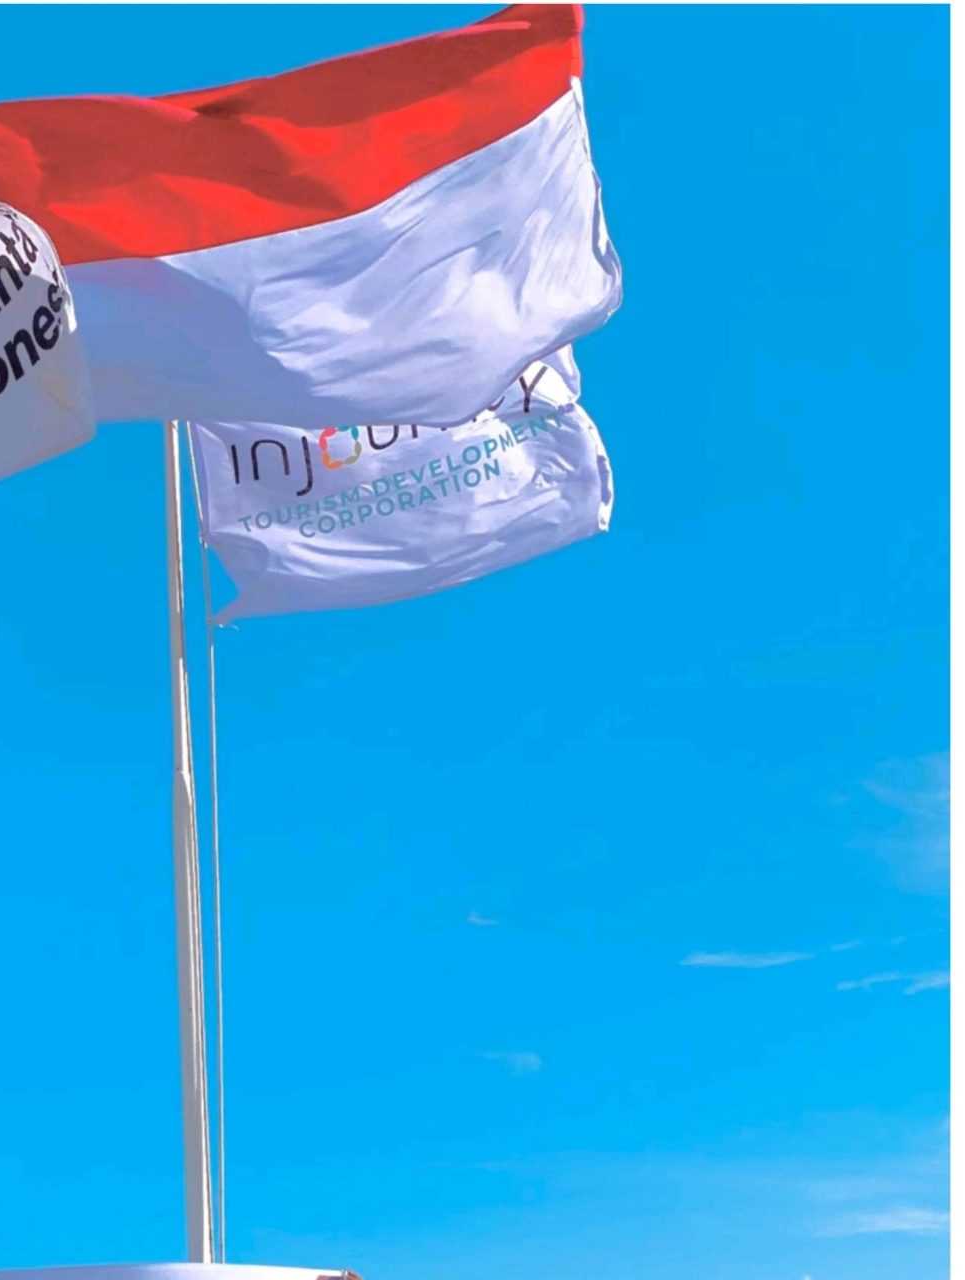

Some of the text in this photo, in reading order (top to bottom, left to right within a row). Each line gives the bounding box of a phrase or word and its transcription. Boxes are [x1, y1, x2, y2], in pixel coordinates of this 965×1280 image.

[238, 412, 563, 533] TOURISM DEVELOPMENT
[299, 459, 501, 539] CORPORATION
